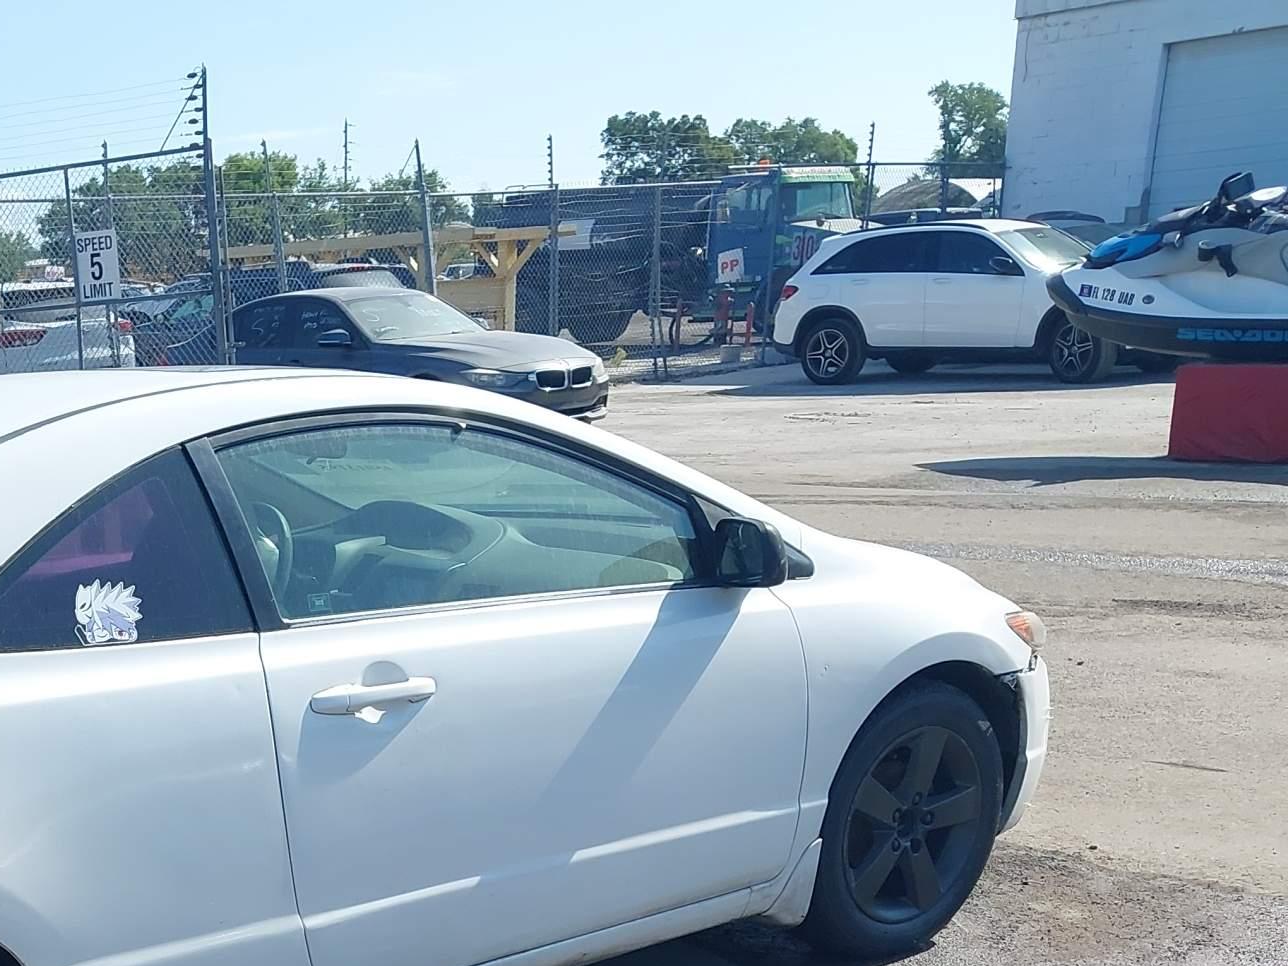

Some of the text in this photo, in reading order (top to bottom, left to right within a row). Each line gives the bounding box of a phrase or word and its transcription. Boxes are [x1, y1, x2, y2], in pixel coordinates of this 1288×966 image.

[77, 235, 113, 253] SPEED
[90, 252, 103, 280] 5
[721, 258, 739, 274] PP
[83, 281, 114, 298] LIMIT
